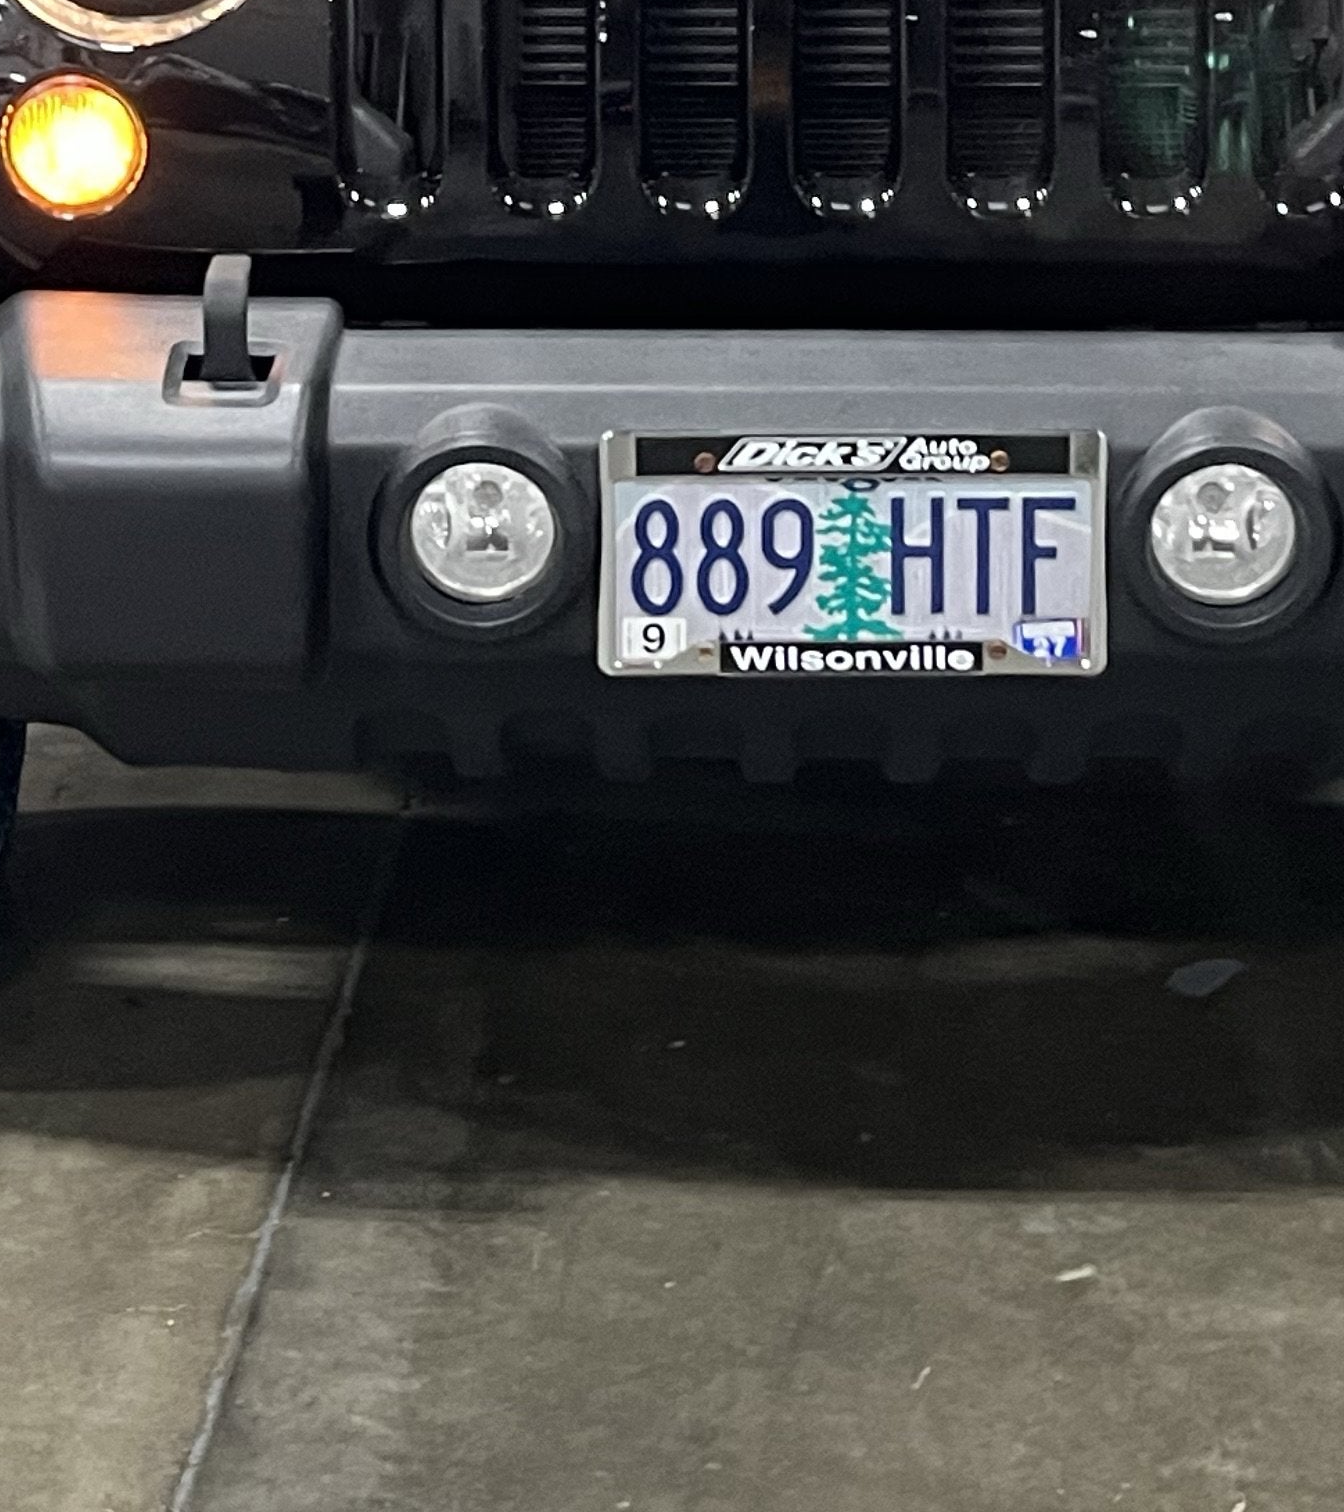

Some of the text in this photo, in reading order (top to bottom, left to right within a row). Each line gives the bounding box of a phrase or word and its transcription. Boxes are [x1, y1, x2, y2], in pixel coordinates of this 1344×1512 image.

[907, 437, 978, 456] Auto
[899, 454, 991, 473] Group
[631, 497, 1077, 616] 889 HTF
[642, 623, 666, 654] 9
[729, 644, 975, 672] Wilsonville
